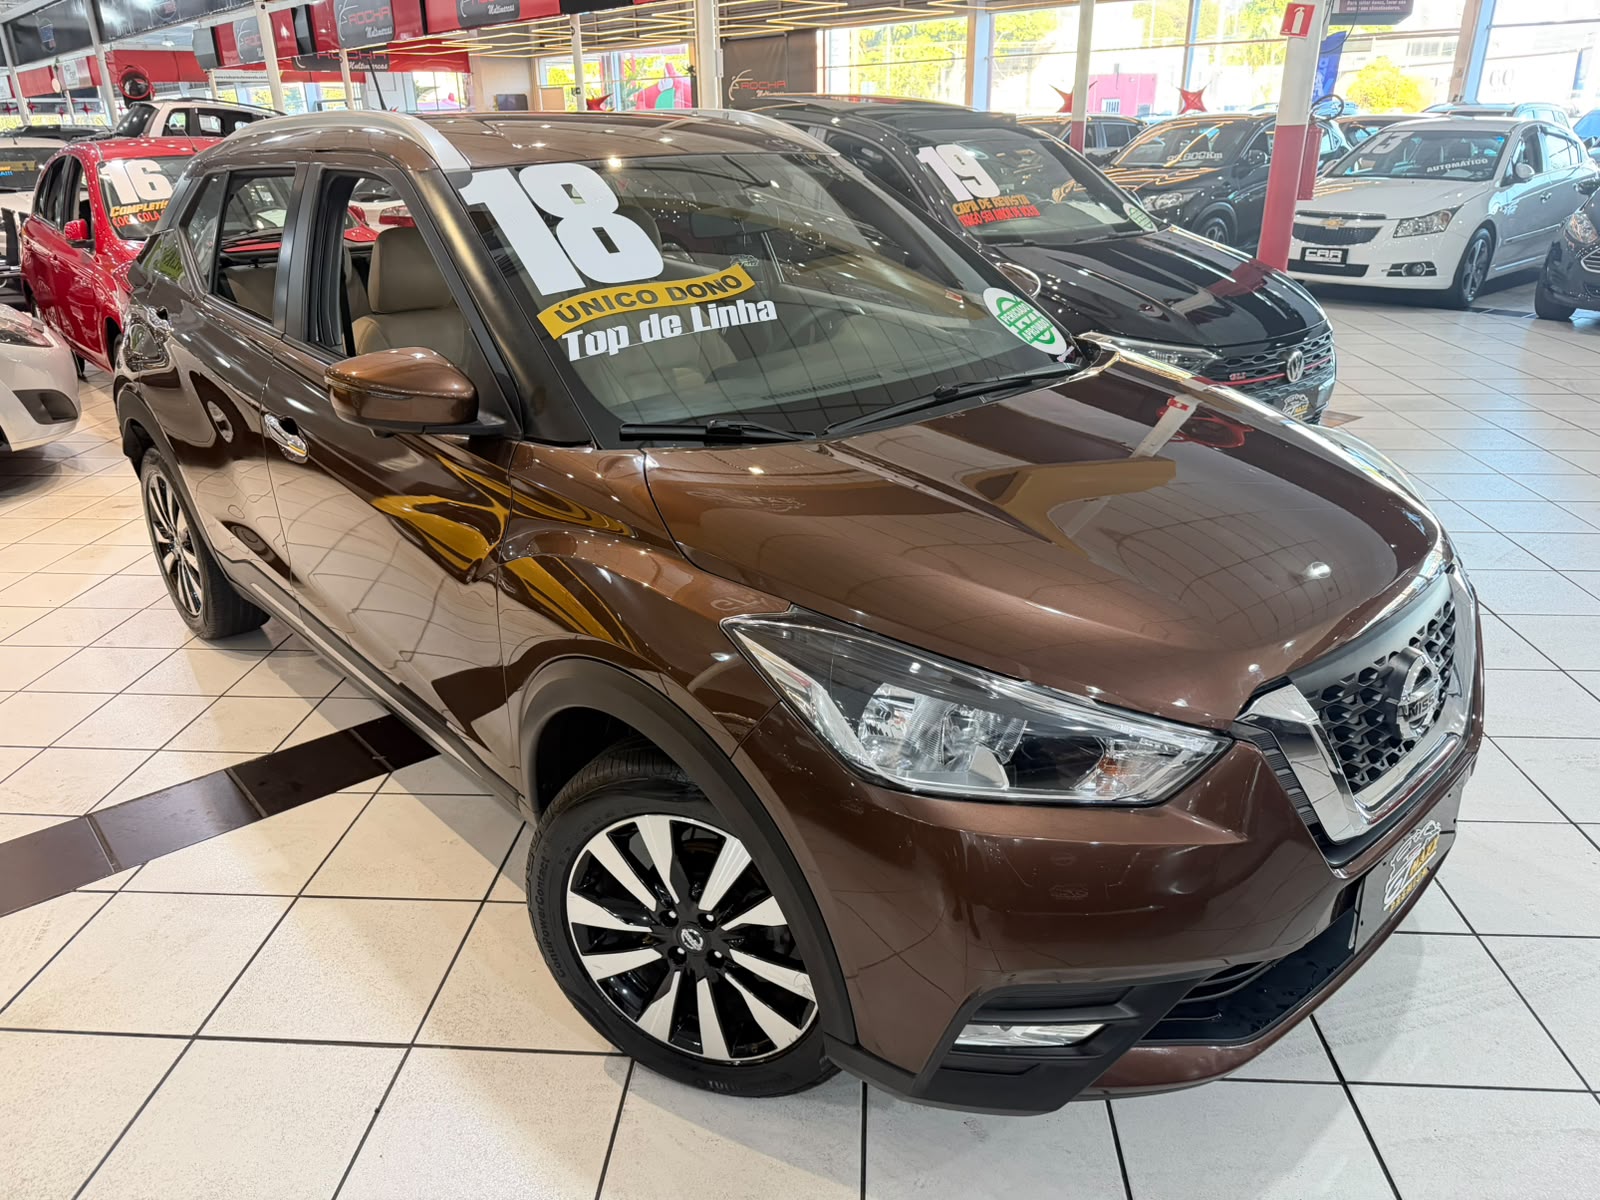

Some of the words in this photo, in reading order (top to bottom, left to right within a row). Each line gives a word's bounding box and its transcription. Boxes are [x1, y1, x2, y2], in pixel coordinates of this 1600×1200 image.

[348, 6, 391, 26] ROCHA
[740, 80, 788, 91] ROCHA
[1360, 131, 1415, 154] 13
[1426, 157, 1489, 173] AUTOMÁTICO
[99, 158, 174, 205] 16
[916, 144, 1001, 201] 19
[952, 199, 979, 216] CAPA
[977, 198, 993, 210] DE
[991, 194, 1031, 208] REVISTA
[458, 162, 664, 296] 18
[555, 288, 659, 324] ÚNICO
[667, 274, 743, 303] DONO
[562, 325, 630, 362] Top
[639, 311, 683, 342] de
[690, 299, 778, 332] Linha
[535, 855, 566, 979] ContiPowerContact
